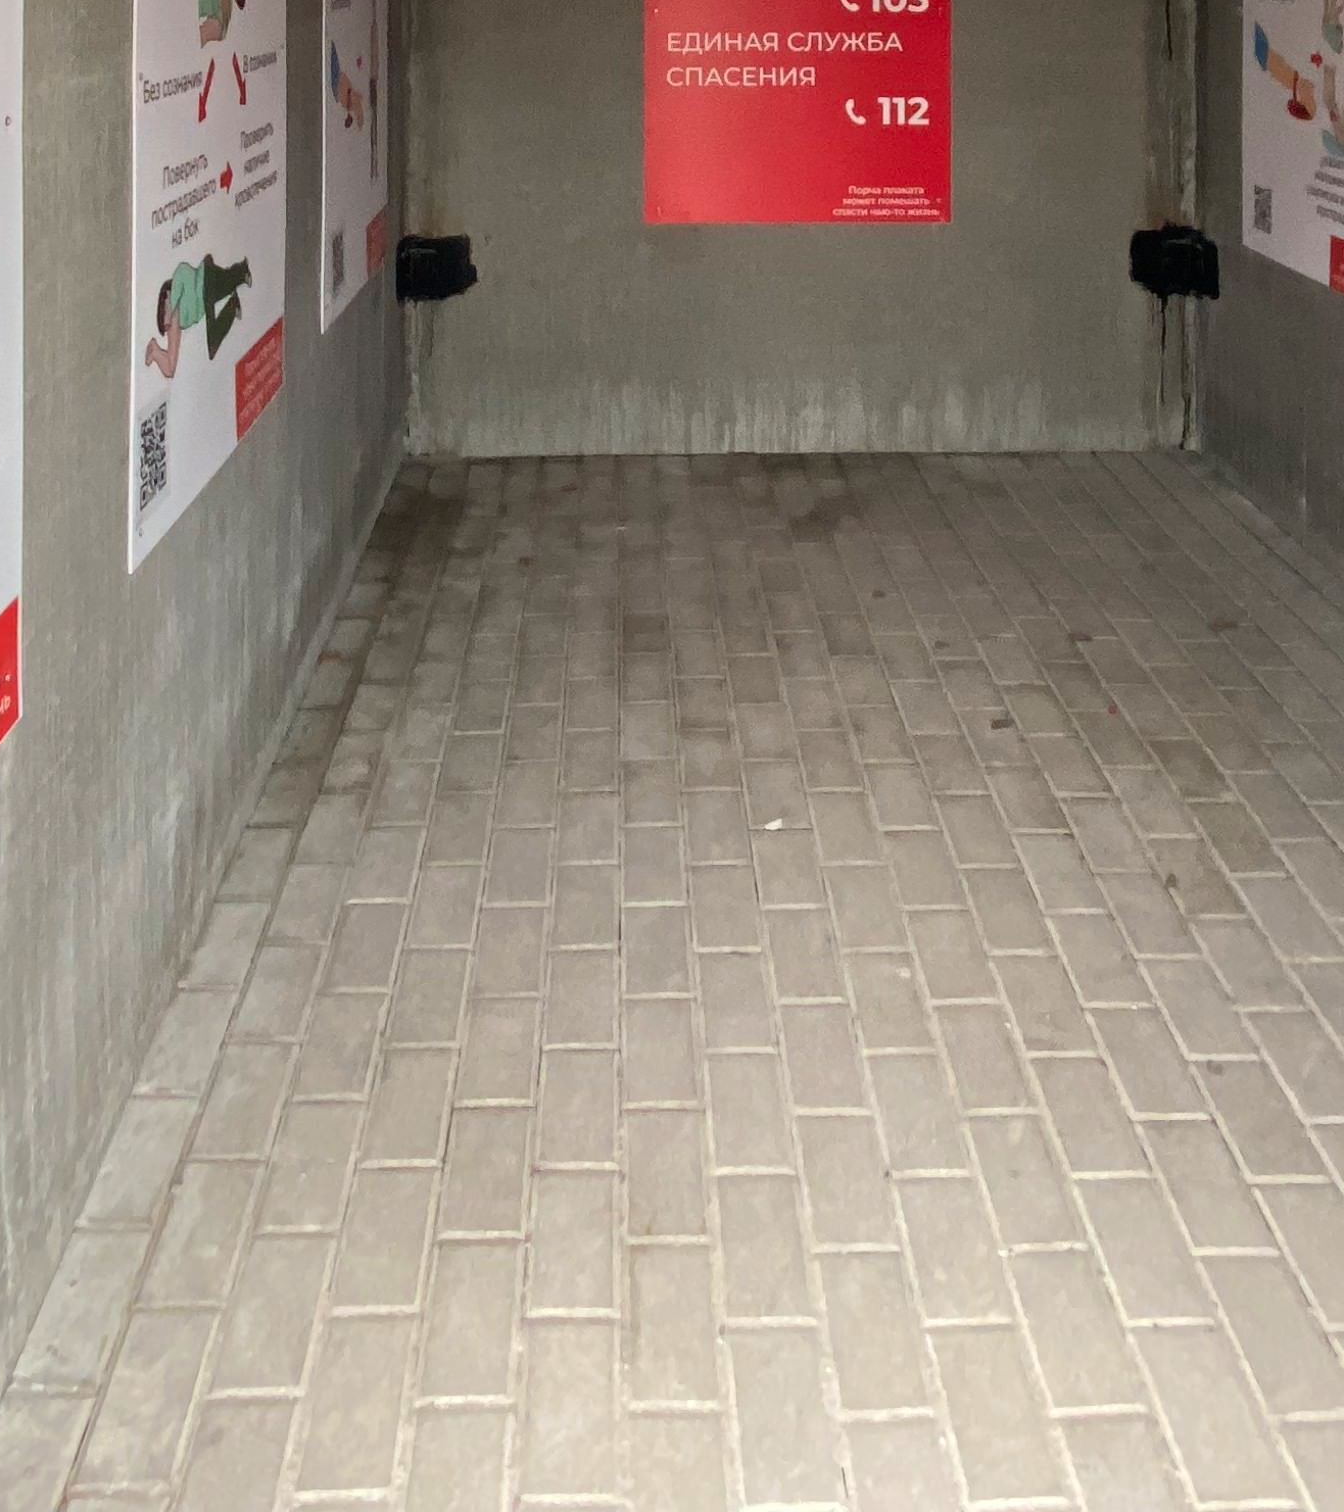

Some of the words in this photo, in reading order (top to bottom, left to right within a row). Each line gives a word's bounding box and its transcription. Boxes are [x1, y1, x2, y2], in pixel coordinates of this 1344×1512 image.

[666, 32, 779, 55] ЕДИНАЯ
[787, 31, 903, 52] СЛУЖБА
[666, 66, 816, 87] СПАСЕНИЯ
[143, 79, 160, 104] Без
[877, 96, 929, 125] 112
